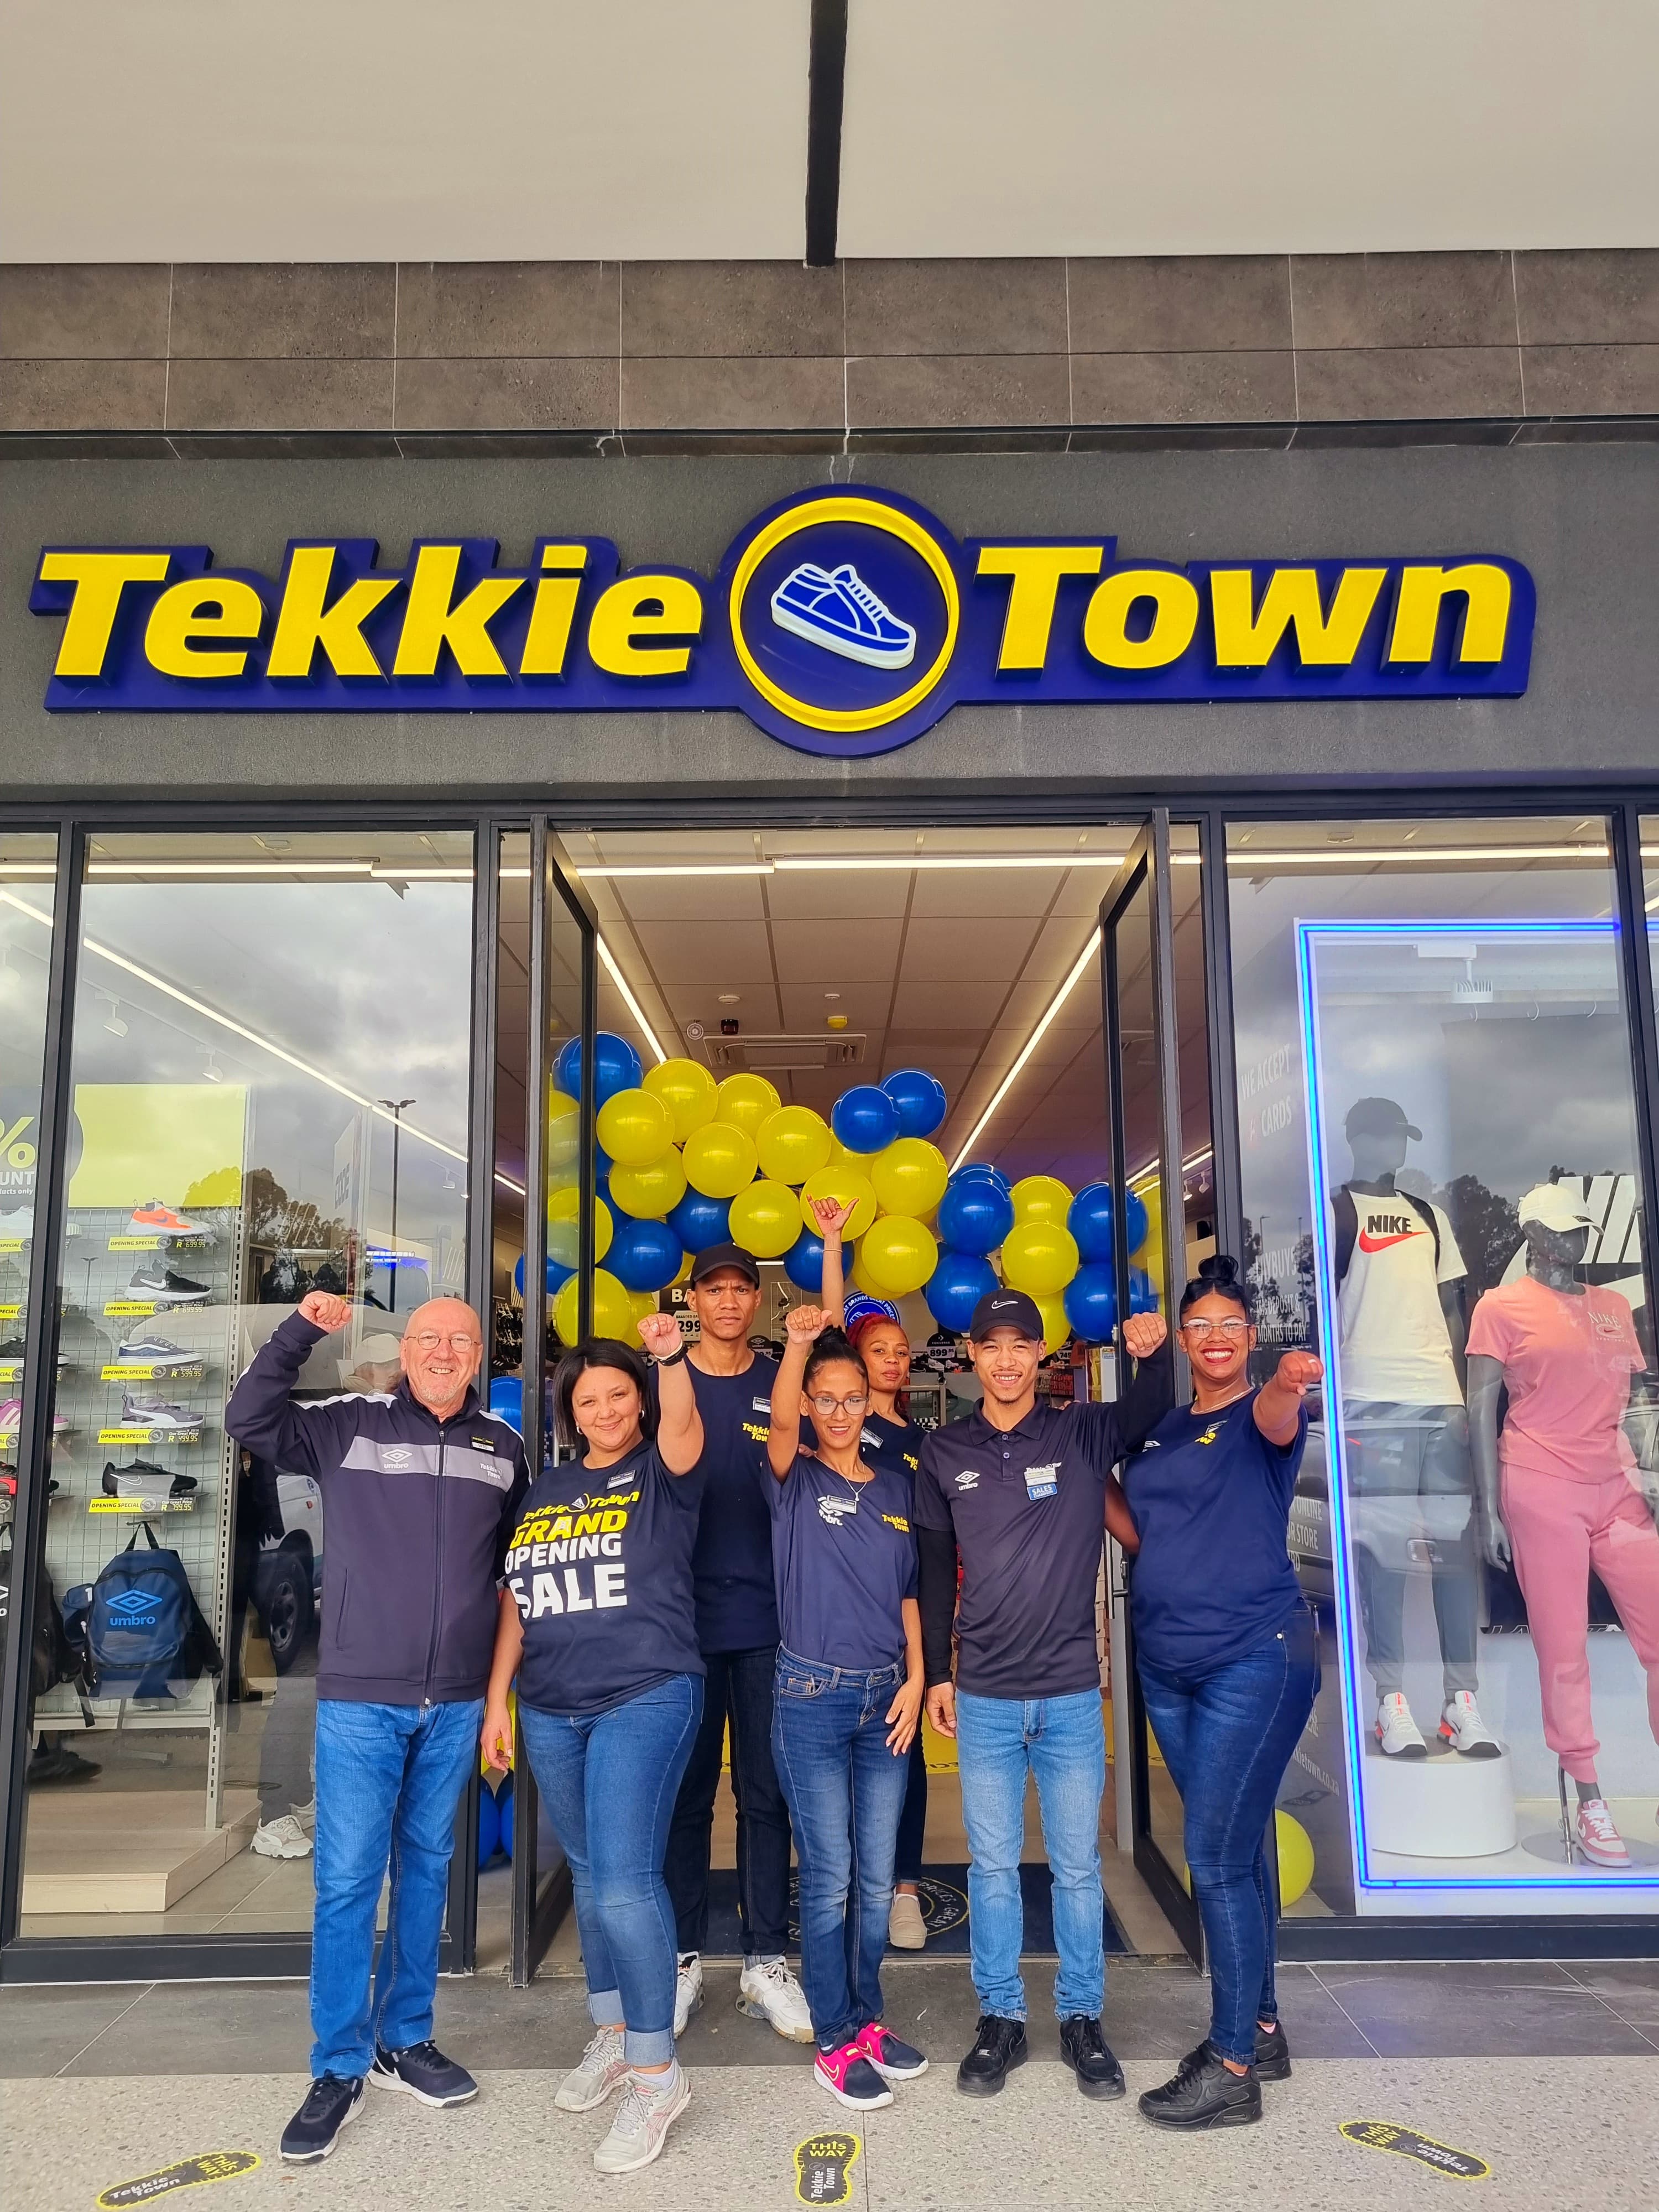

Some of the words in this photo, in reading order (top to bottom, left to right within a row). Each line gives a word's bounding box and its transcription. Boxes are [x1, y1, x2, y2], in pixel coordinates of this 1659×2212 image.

[40, 545, 703, 678] Tekkie
[977, 545, 1512, 670] Town
[1241, 1069, 1256, 1100] WE
[1257, 1043, 1290, 1092] ACCEPT
[1261, 1095, 1292, 1138] CARDS
[1368, 1215, 1412, 1234] NIKE
[848, 1295, 868, 1306] BRANDS
[1267, 1293, 1294, 1315] DEPOSIT
[678, 1320, 701, 1332] 299
[1587, 1311, 1621, 1328] NIKE
[1258, 1323, 1284, 1343] MONTHS
[1285, 1322, 1293, 1343] TO
[1295, 1321, 1307, 1342] PAY
[958, 1482, 978, 1491] umbro
[1032, 1484, 1052, 1495] SALES
[523, 1504, 570, 1522] ekkie
[589, 1491, 639, 1510] Town
[1297, 1494, 1322, 1521] ONLINE
[509, 1510, 628, 1549] GRAND
[881, 1514, 908, 1526] Tekkie
[894, 1521, 910, 1533] Town
[1296, 1523, 1319, 1551] STORE
[504, 1532, 622, 1574] OPENING
[509, 1563, 628, 1619] SALE
[110, 1615, 156, 1626] umbro
[1359, 2125, 1390, 2139] THIS
[1372, 2130, 1401, 2145] WAY
[809, 2140, 847, 2150] THIS
[1417, 2143, 1459, 2162] Town
[197, 2159, 222, 2176] WAY
[212, 2154, 239, 2172] THIS
[1417, 2149, 1470, 2172] Tekkie
[110, 2176, 169, 2199] Tekkie
[135, 2178, 180, 2197] Town
[811, 2171, 824, 2199] Tekkie
[823, 2167, 836, 2189] Town
